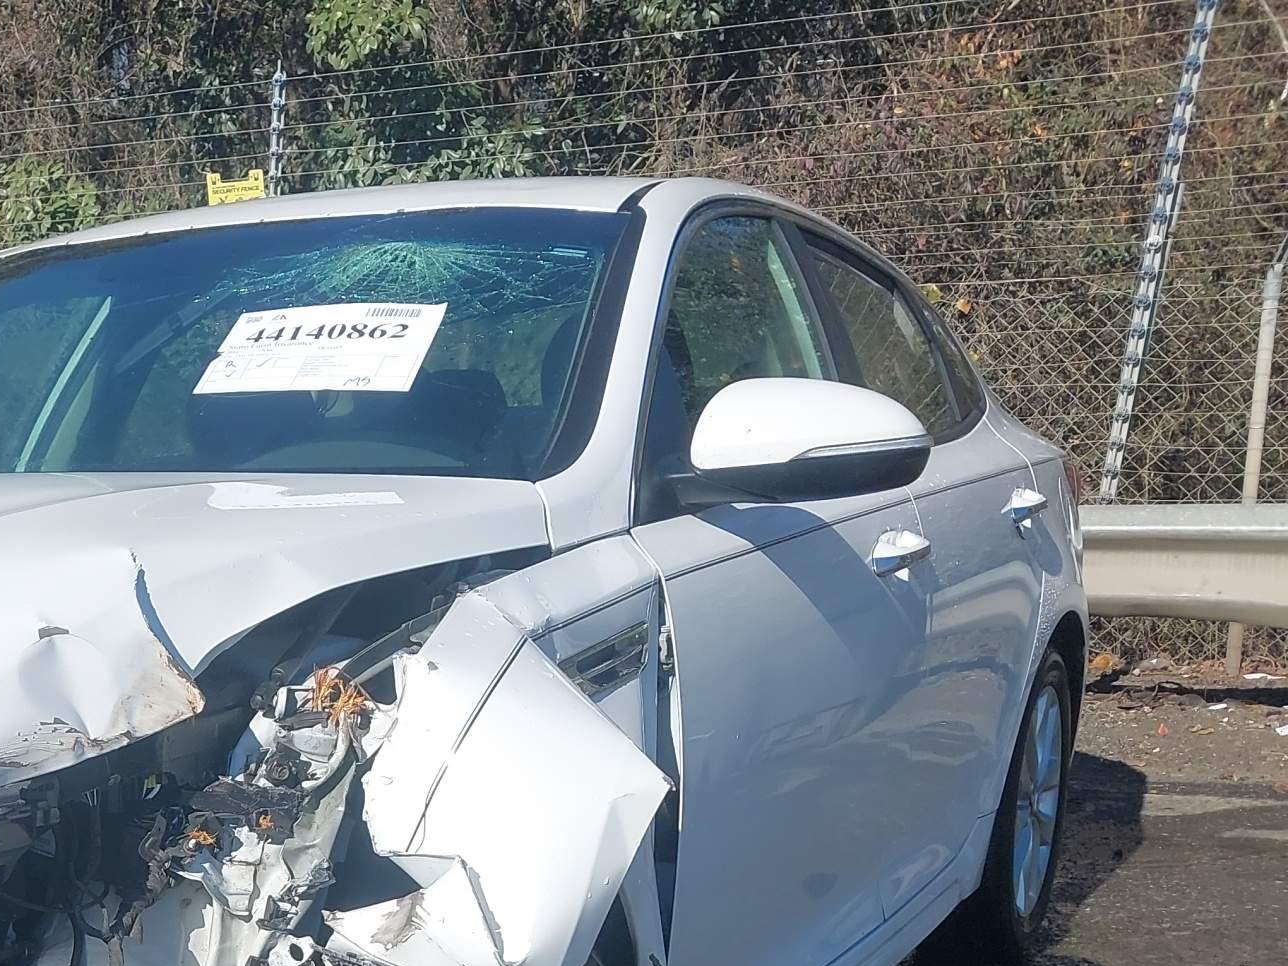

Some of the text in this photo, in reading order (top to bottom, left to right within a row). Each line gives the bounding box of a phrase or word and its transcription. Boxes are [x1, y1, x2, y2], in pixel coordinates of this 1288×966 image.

[212, 187, 240, 195] SECURITY
[241, 185, 260, 193] FENCE
[245, 322, 410, 343] 44140862
